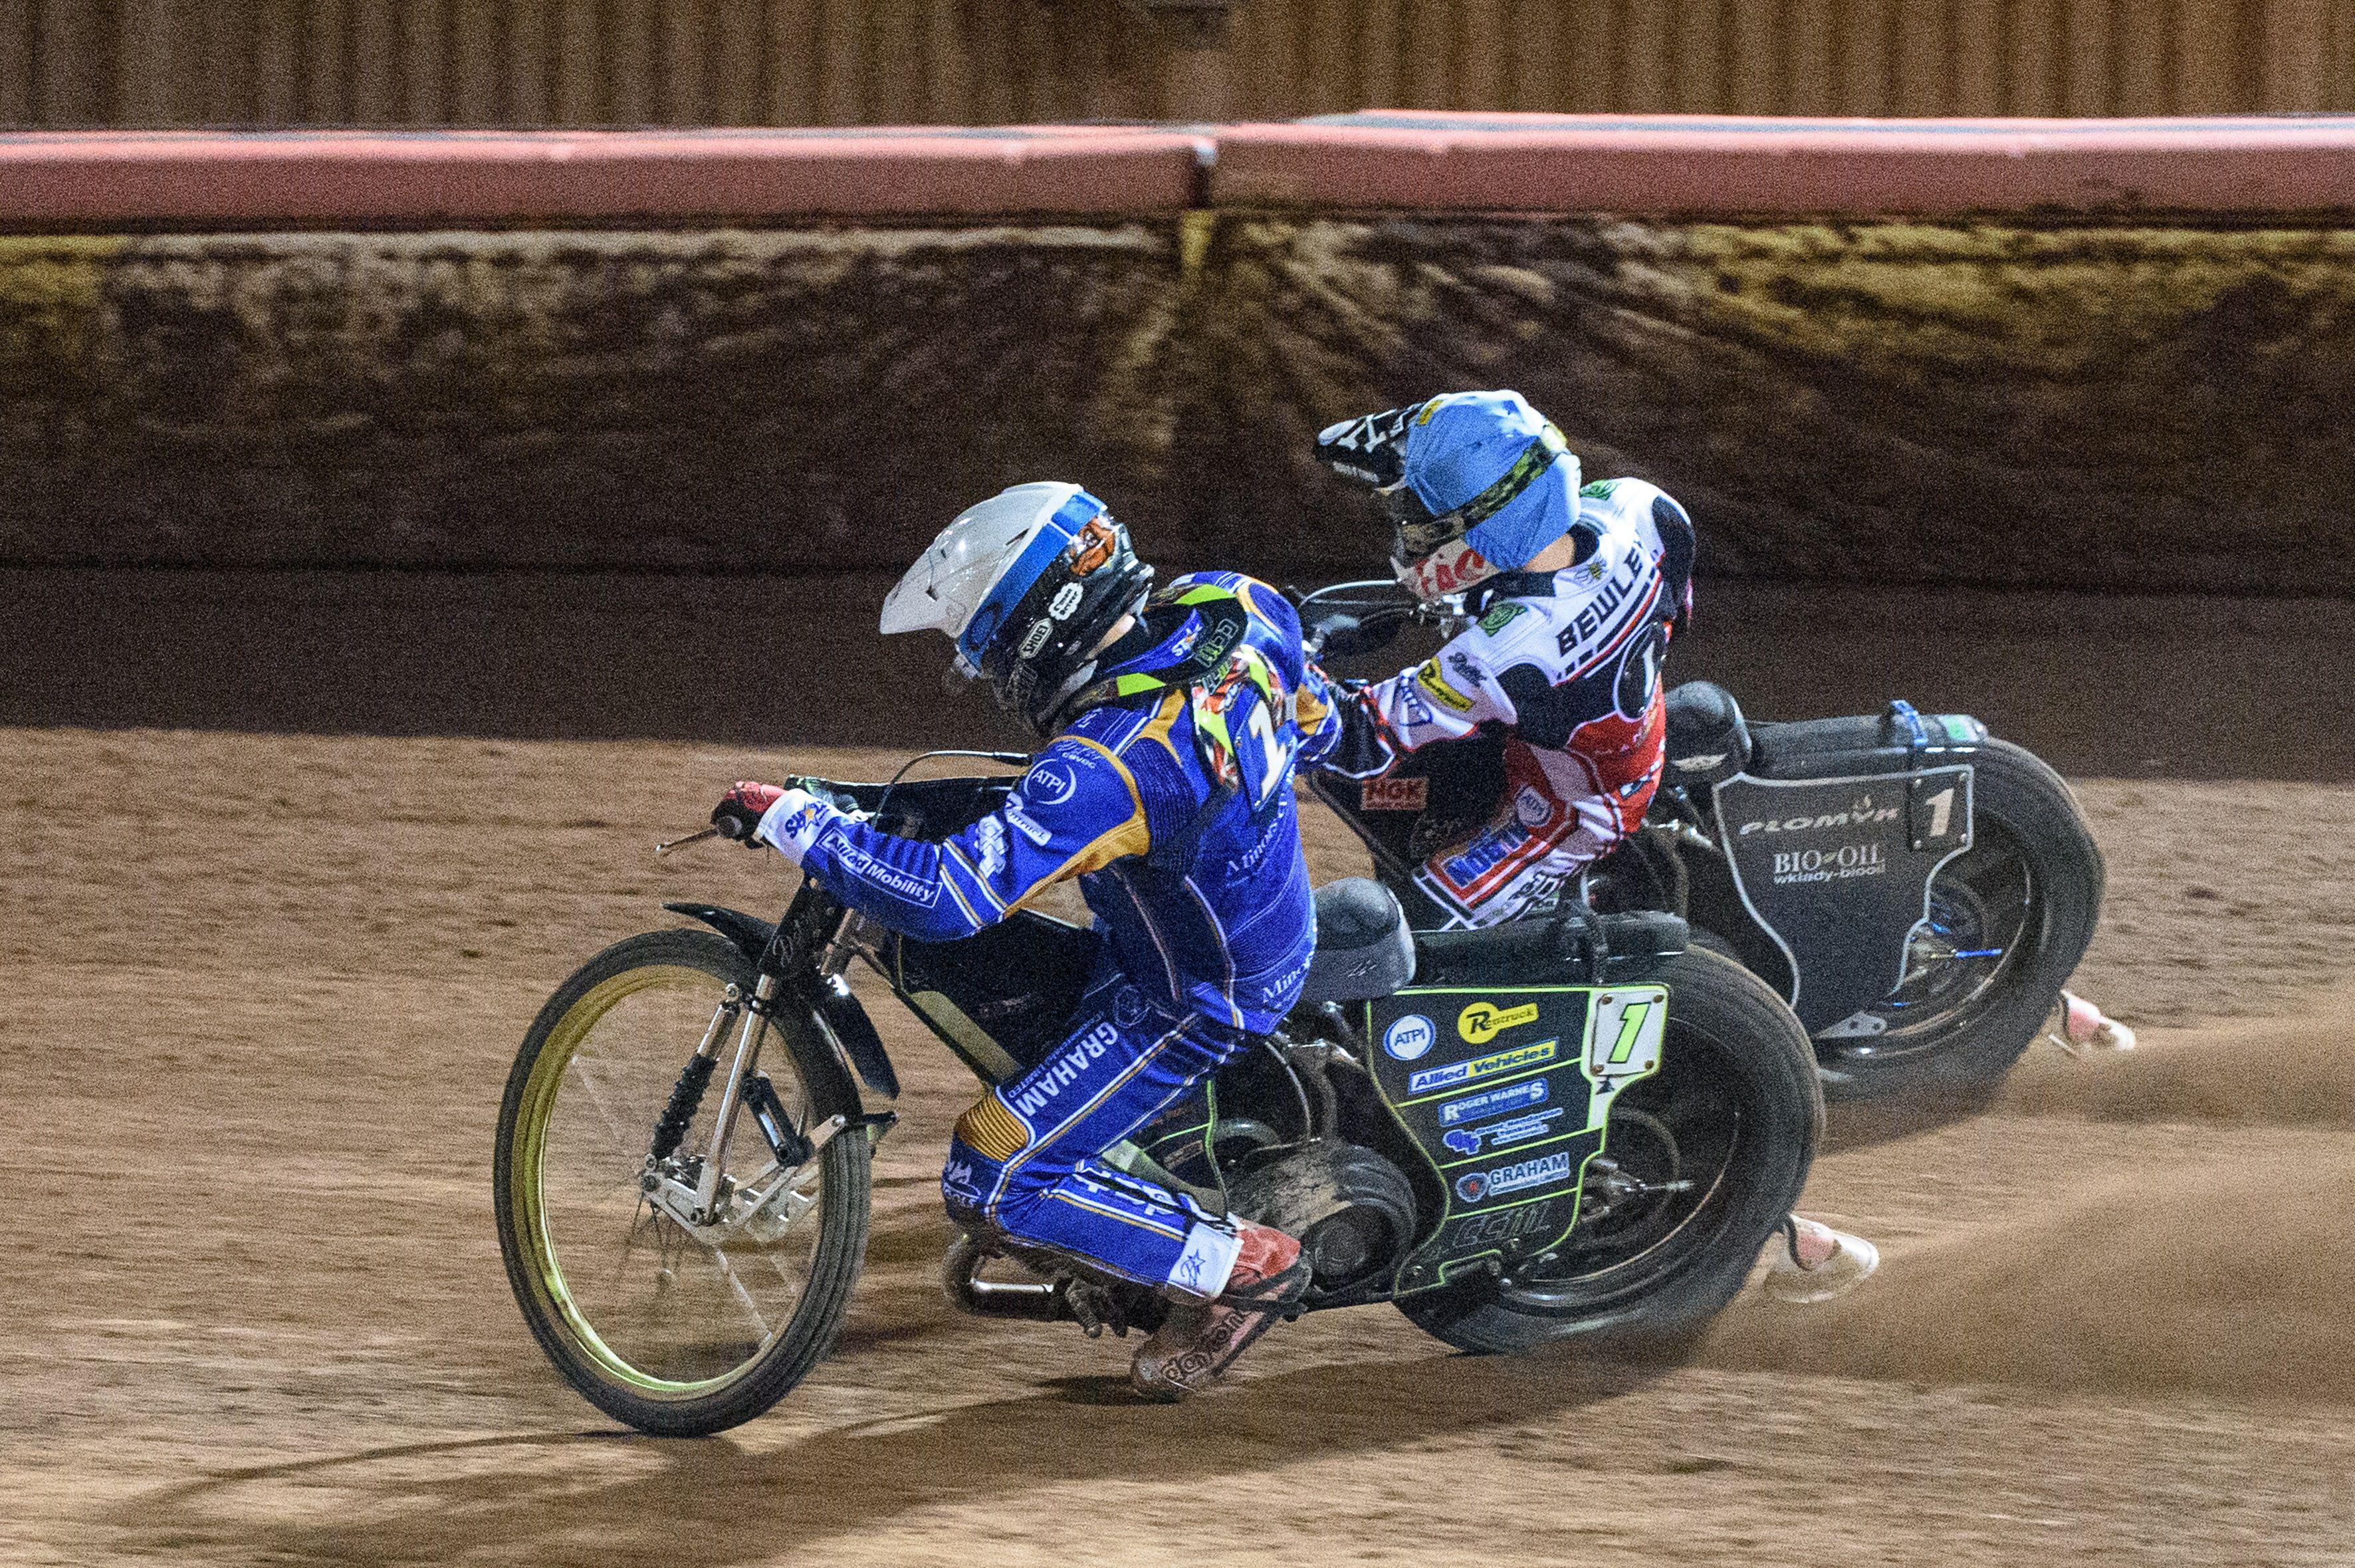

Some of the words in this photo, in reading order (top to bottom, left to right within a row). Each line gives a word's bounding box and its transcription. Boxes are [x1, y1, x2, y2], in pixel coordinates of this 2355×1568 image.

[1556, 540, 1643, 658] BEWLE
[1031, 769, 1066, 794] ATPI
[1366, 783, 1423, 798] NGK
[1925, 788, 1955, 838] 1
[828, 836, 867, 870] Allied
[867, 864, 935, 902] Mobility
[1394, 1028, 1426, 1047] ATPI
[1466, 1008, 1534, 1035] Rentruck
[1607, 1002, 1652, 1064] 1
[1015, 1022, 1118, 1117] GRAHAM
[1415, 1066, 1468, 1088] Allied
[1473, 1046, 1551, 1073] Vehicles
[1490, 1153, 1569, 1185] GRAHAM
